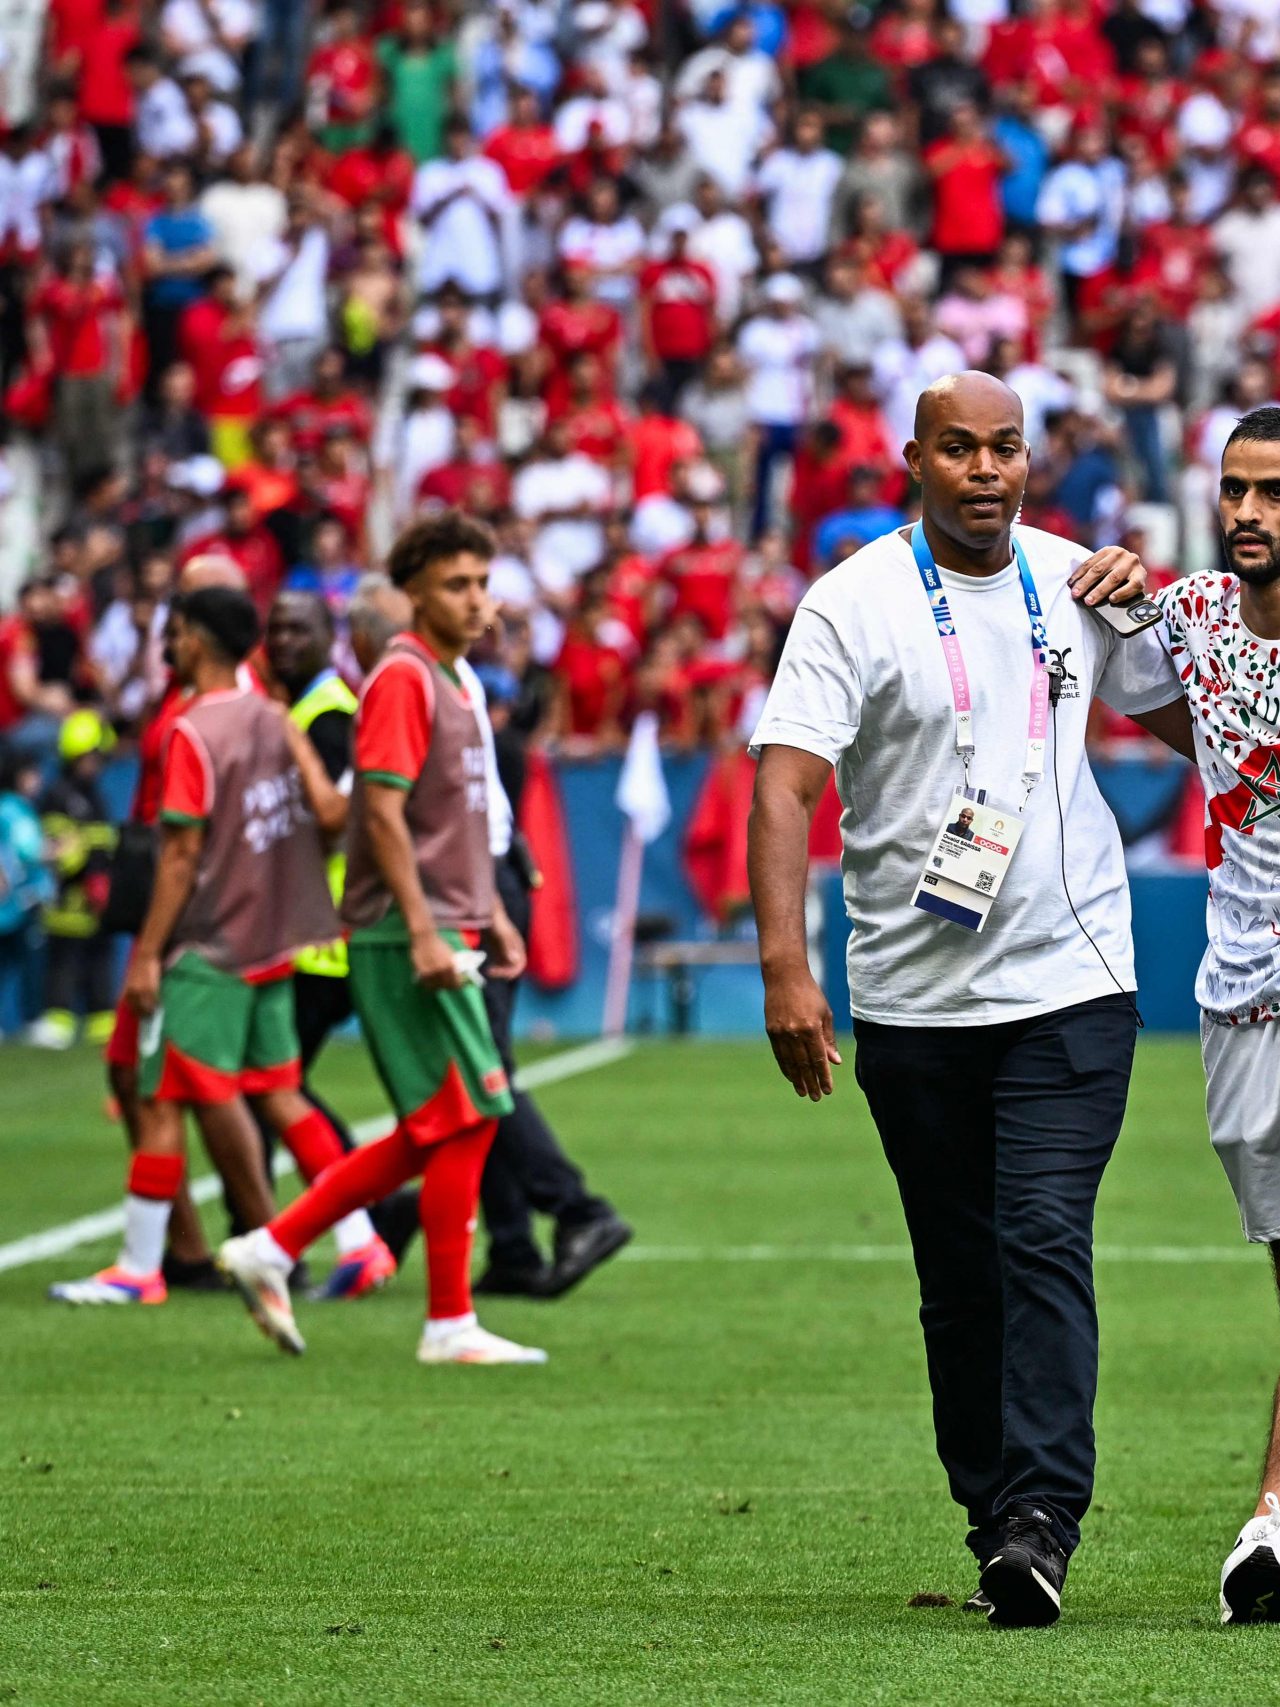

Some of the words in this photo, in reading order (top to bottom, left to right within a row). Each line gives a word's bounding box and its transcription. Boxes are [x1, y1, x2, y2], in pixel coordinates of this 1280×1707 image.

[924, 569, 936, 587] Atos
[1028, 593, 1038, 612] Atos
[947, 641, 961, 673] PARIS
[955, 676, 966, 707] 2024
[1033, 702, 1045, 735] PARIS
